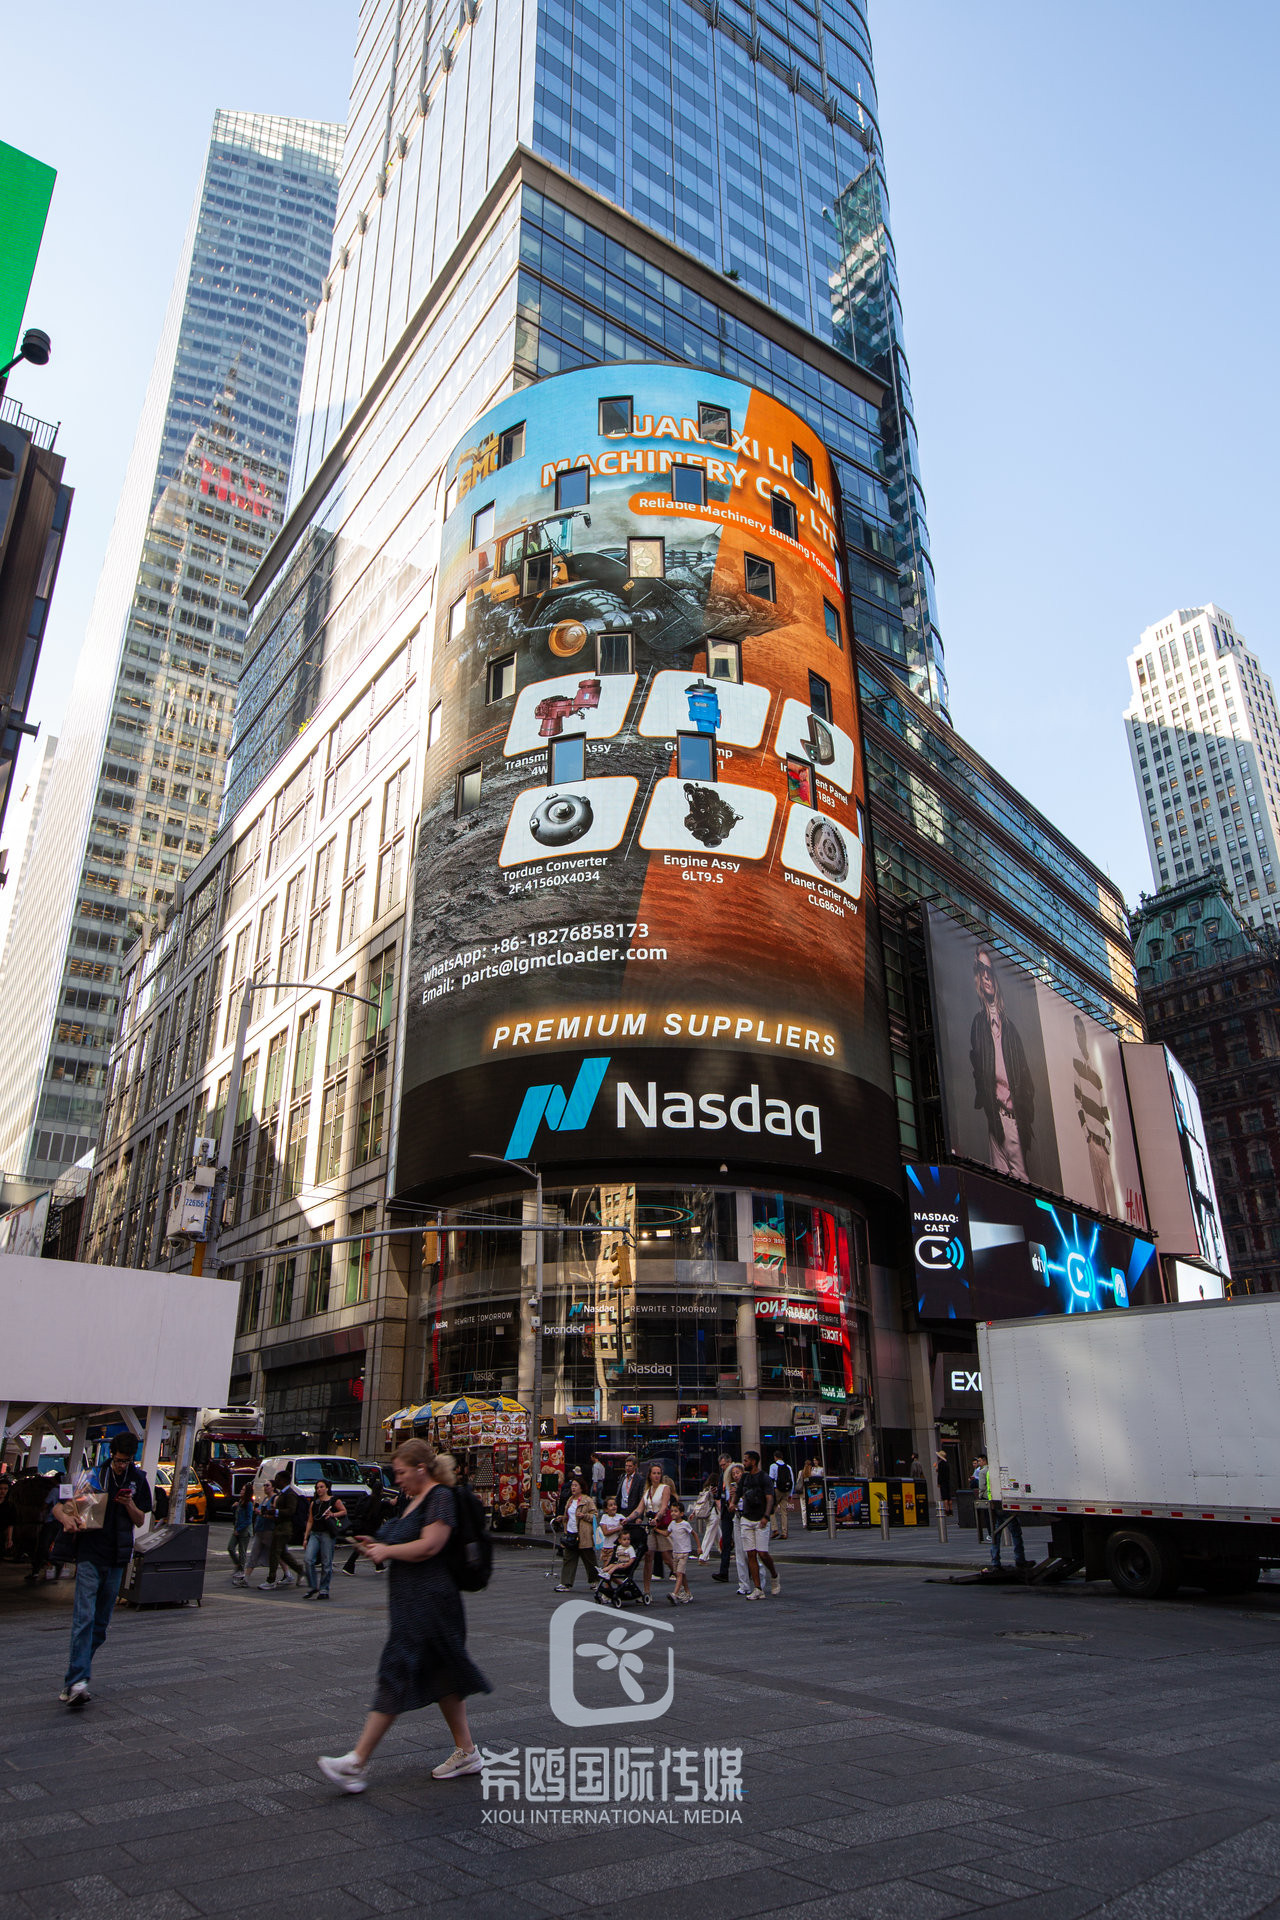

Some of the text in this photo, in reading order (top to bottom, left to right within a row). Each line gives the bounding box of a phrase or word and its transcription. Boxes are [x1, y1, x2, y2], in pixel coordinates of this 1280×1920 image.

[604, 415, 760, 462] UANXI
[639, 498, 697, 512] Reliable
[700, 505, 767, 532] Machinery
[769, 526, 810, 558] Building
[505, 743, 612, 771] Transmi Assy
[817, 790, 836, 808] 1883
[829, 785, 849, 806] Panel
[546, 856, 608, 872] Converter
[663, 855, 740, 873] Engine Assy
[784, 872, 858, 915] Planet Carier Assy
[808, 894, 845, 918] CLG862H
[423, 922, 650, 985] whatsApp: +86-18276858173
[422, 945, 668, 1005] Email: parts@lgmcloader.com
[492, 1013, 836, 1057] PREMIUM SUPPLIERS
[617, 1081, 823, 1155] Nasdaq
[913, 1212, 959, 1224] NASDAQ:
[1125, 1187, 1145, 1229] H&M
[924, 1224, 951, 1233] CAST
[477, 1312, 513, 1322] TOMORROW
[584, 1305, 615, 1314] Nasdaq
[630, 1305, 718, 1314] REWRITE TOMORROW
[628, 1363, 673, 1377] Nasdaq
